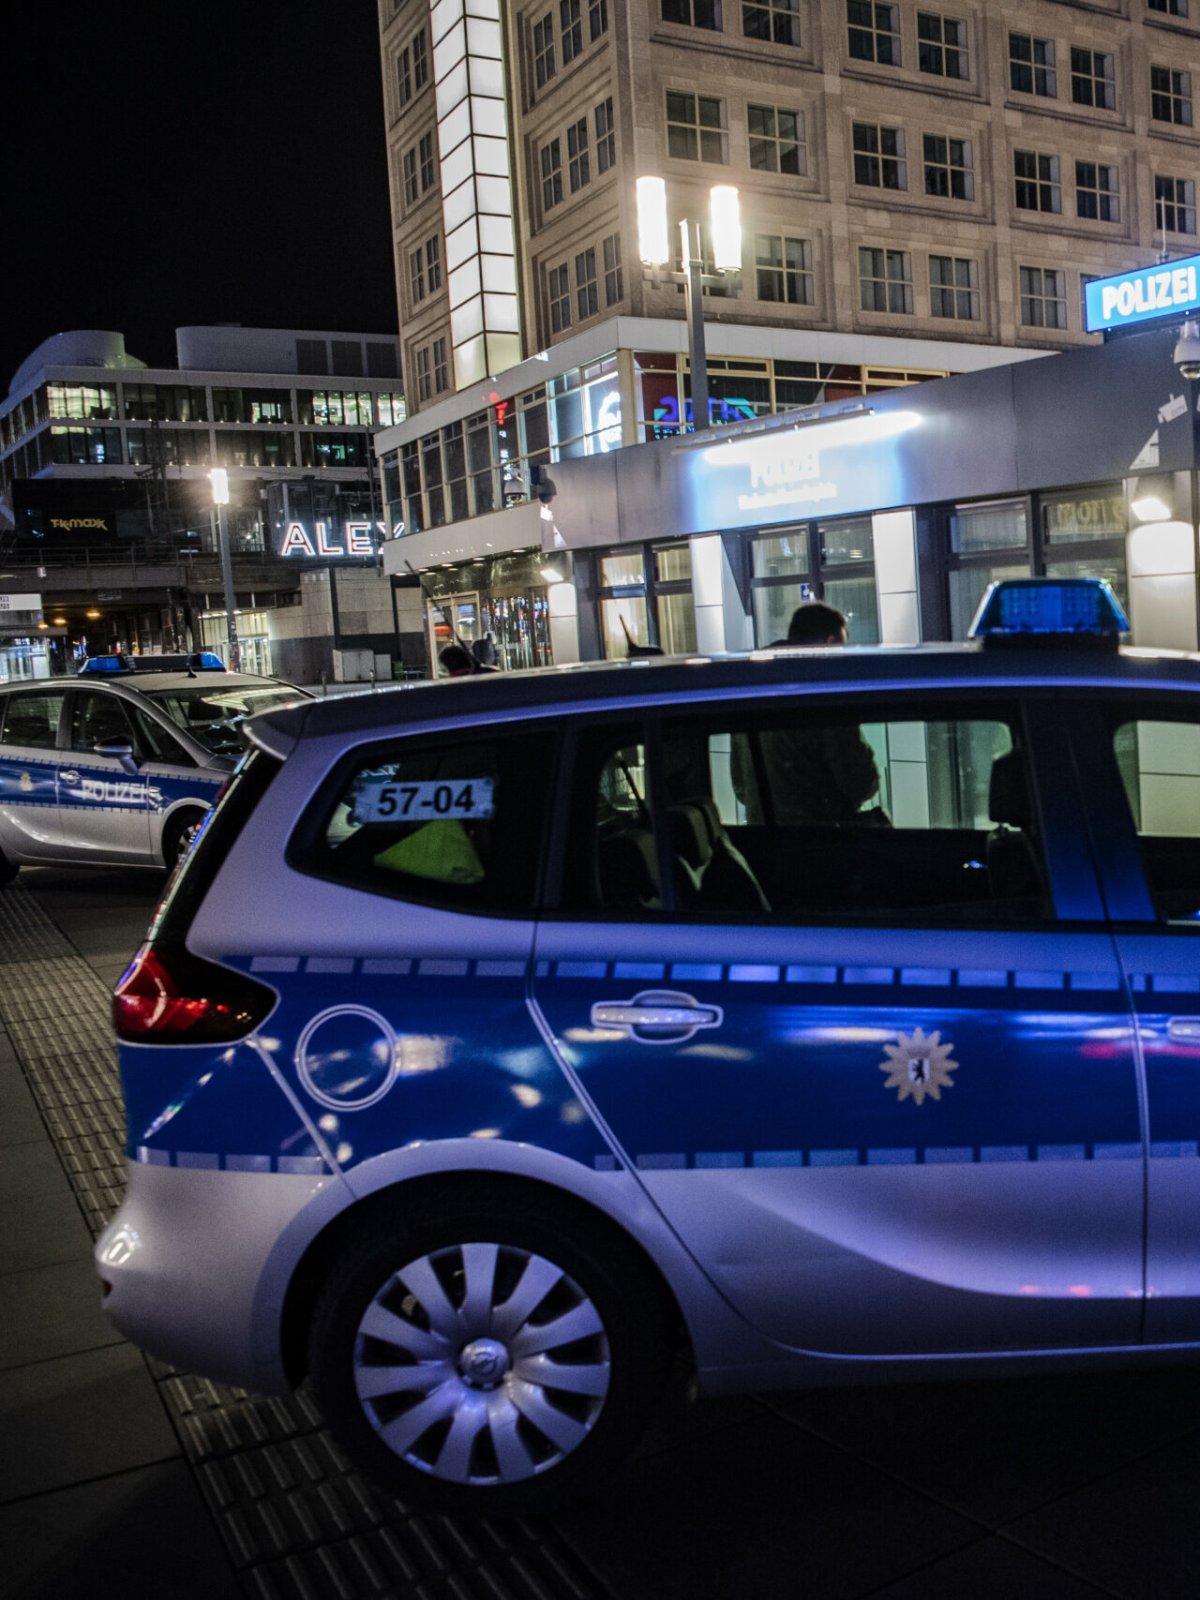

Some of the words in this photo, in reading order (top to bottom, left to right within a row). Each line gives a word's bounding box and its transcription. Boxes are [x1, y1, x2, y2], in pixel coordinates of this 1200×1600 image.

[1102, 266, 1197, 320] POLIZEI
[82, 779, 147, 801] POLIZEI
[377, 784, 475, 816] 57-04
